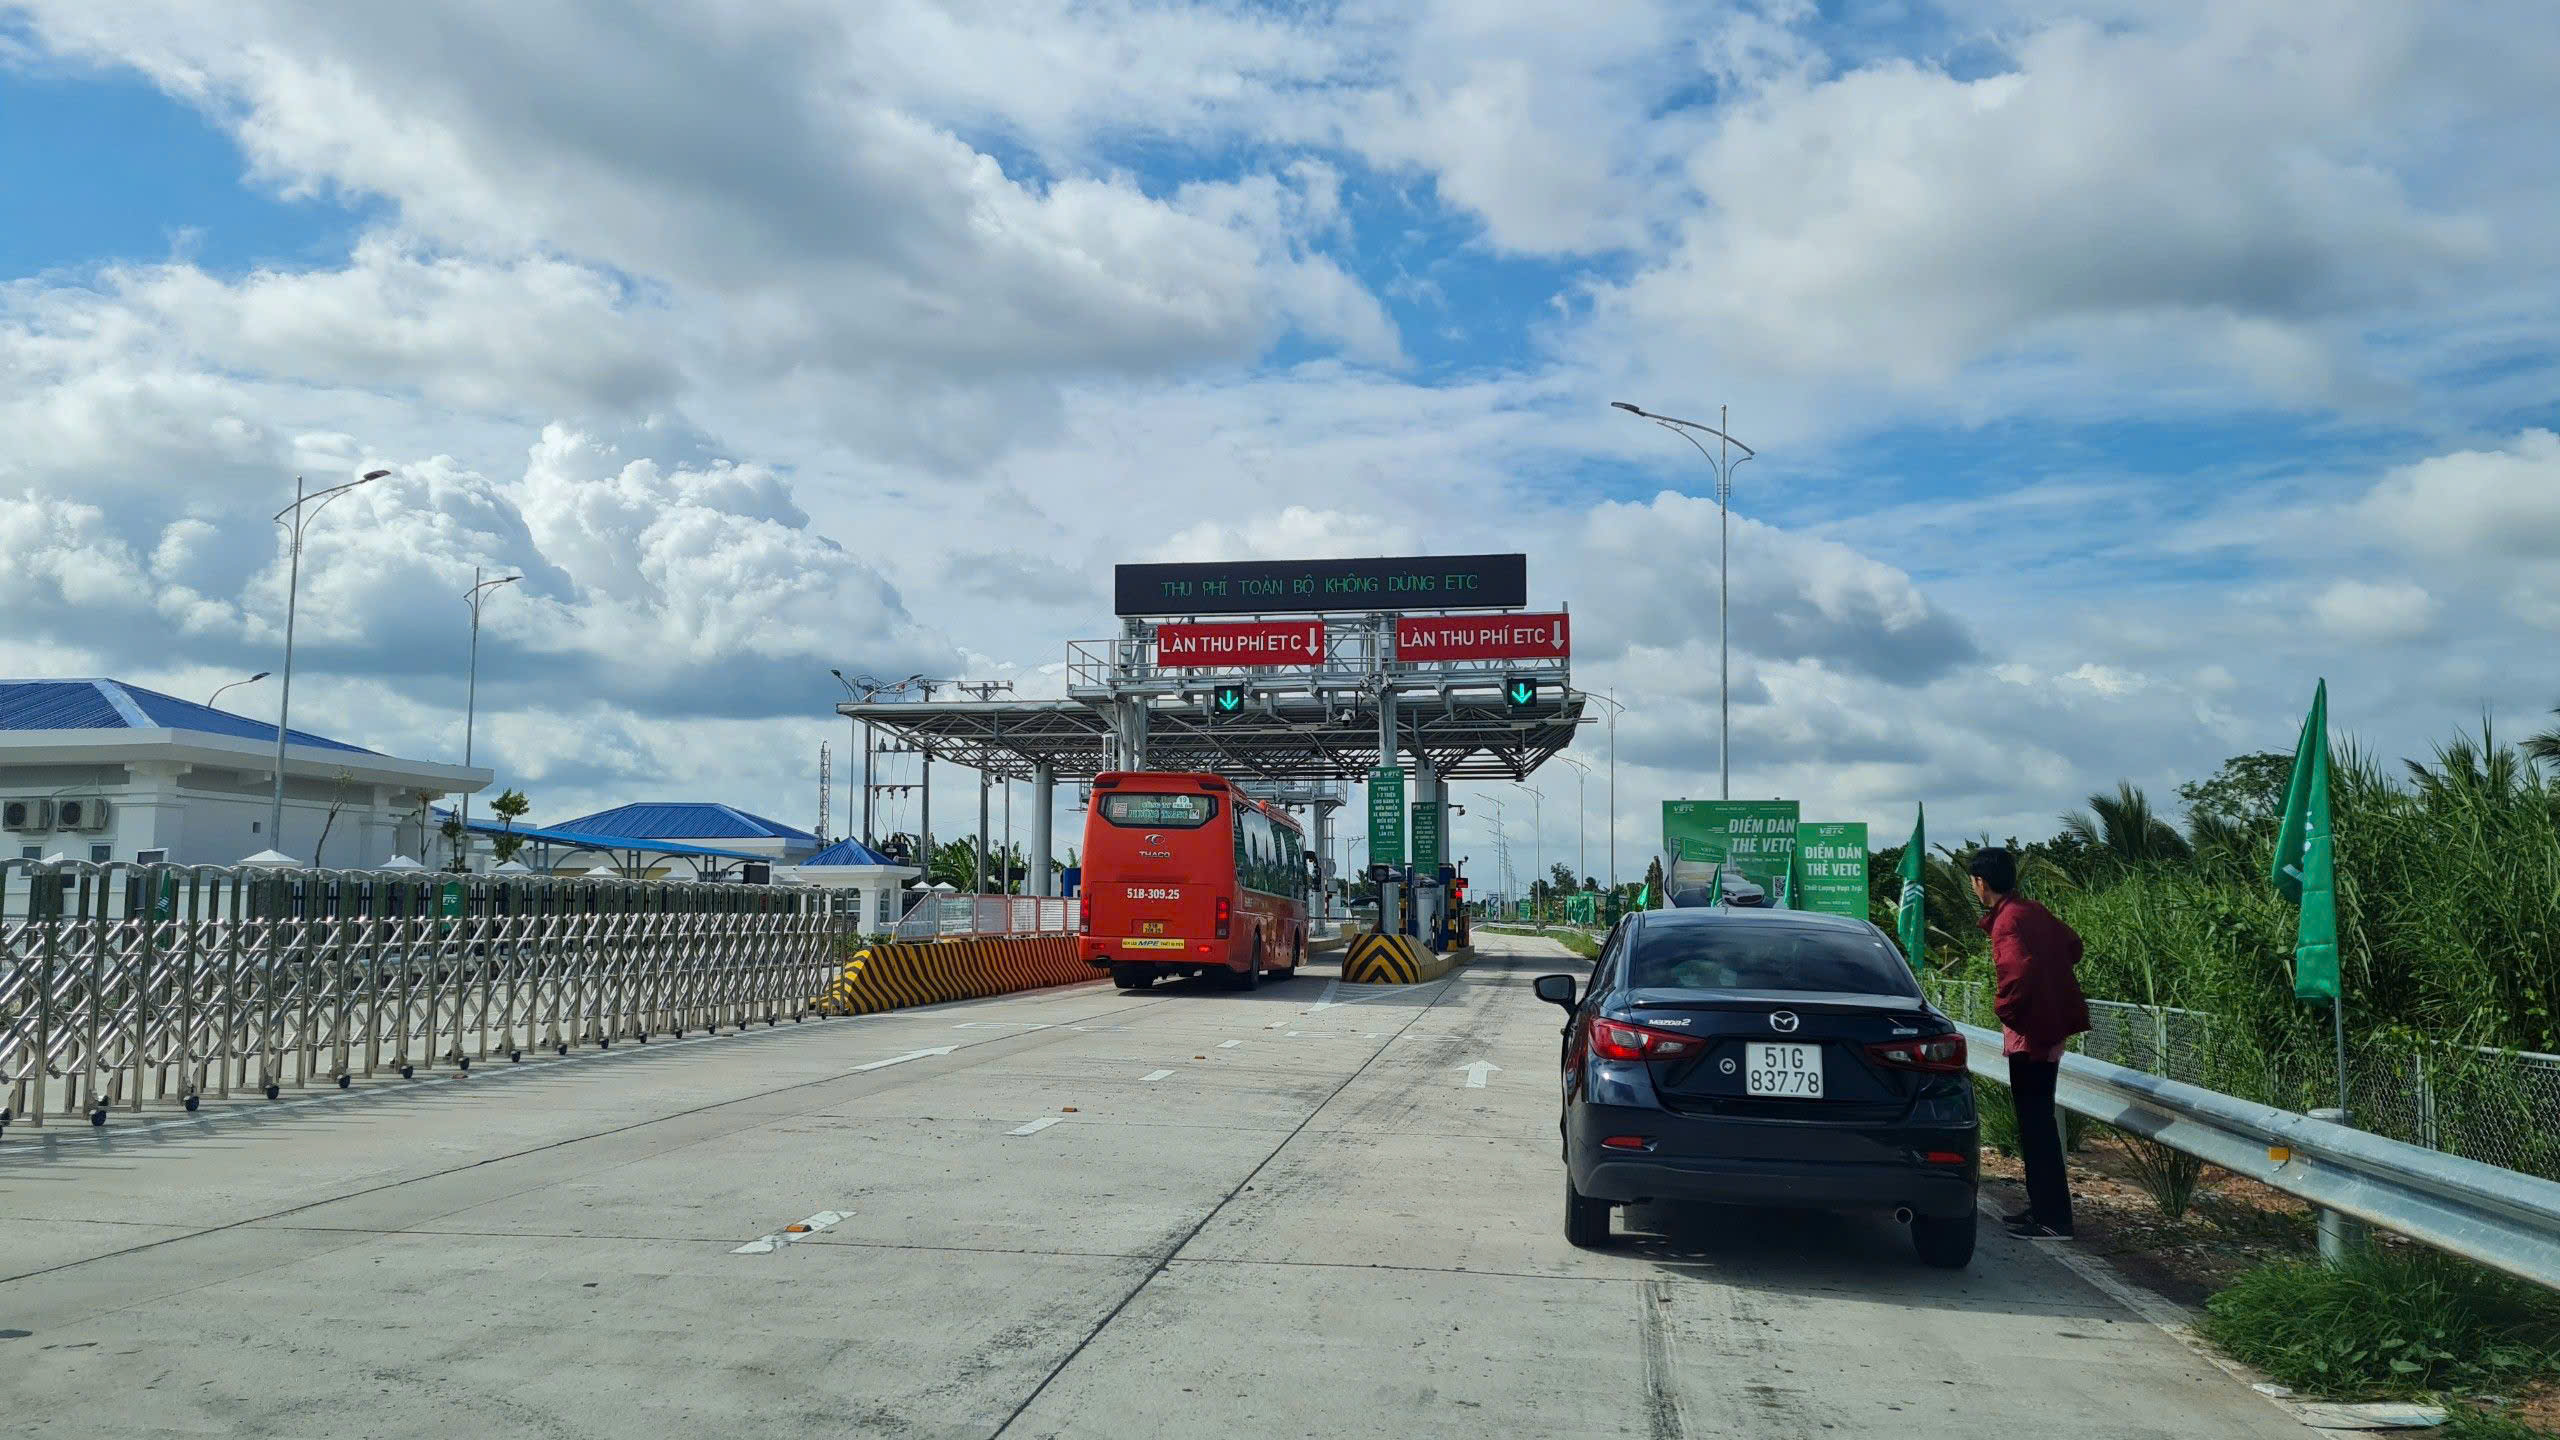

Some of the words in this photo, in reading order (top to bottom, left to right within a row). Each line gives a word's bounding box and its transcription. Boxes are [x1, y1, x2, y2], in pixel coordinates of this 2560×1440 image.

[1161, 581, 1192, 597] THU
[1202, 576, 1228, 596] PHÍ
[1238, 575, 1283, 595] TOÀN
[1293, 573, 1315, 598] BỘ
[1325, 572, 1378, 593] KHÔNG
[1388, 571, 1435, 592] DỪNG
[1445, 574, 1478, 590] ETC
[1160, 632, 1196, 653] LÀN
[1200, 636, 1232, 652] THU
[1237, 631, 1266, 651] PHÍ
[1267, 634, 1302, 651] ETC
[1400, 626, 1436, 648] LÀN
[1440, 630, 1475, 647] THU
[1479, 624, 1510, 645] PHÍ
[1513, 628, 1546, 645] ETC
[1673, 804, 1694, 812] VETC
[1766, 815, 1796, 833] DÁN
[1732, 835, 1758, 853] THẺ
[1762, 838, 1796, 853] VETC
[1805, 841, 1834, 859] ĐIỂM
[1838, 842, 1862, 859] DÁN
[1807, 860, 1829, 876] THẺ
[1832, 863, 1861, 876] VETC
[1127, 888, 1180, 900] 51B-309.25
[1765, 1046, 1804, 1069] 51G
[1750, 1069, 1820, 1094] 837.78
